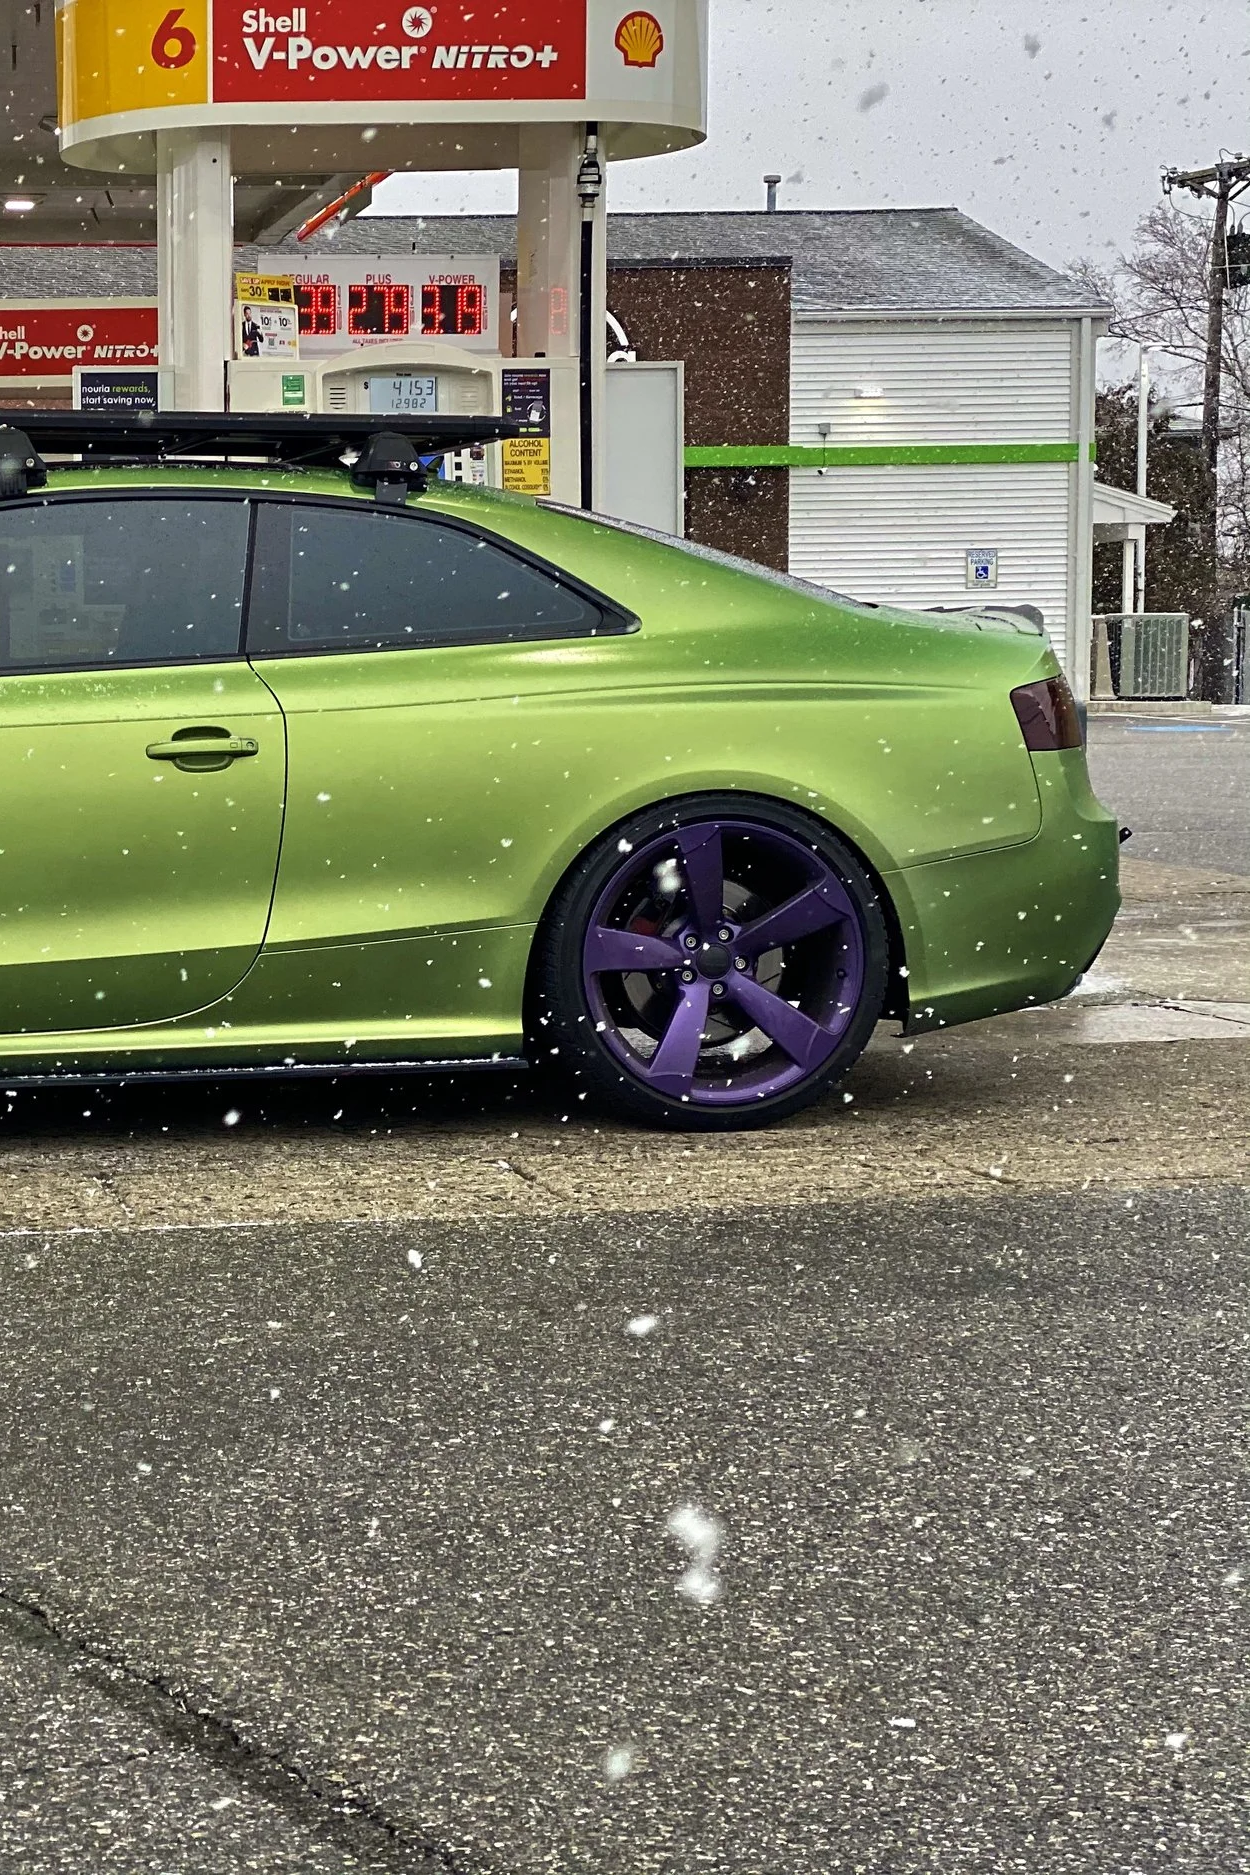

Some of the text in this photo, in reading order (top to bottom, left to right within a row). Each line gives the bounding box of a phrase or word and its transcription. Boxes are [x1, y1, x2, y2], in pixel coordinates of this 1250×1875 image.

[242, 8, 306, 33] Shell
[151, 8, 196, 69] 6
[242, 36, 418, 70] V-Power
[365, 274, 392, 285] PLUS
[429, 275, 476, 285] V-POWER
[363, 381, 369, 390] $
[82, 396, 101, 404] start
[103, 396, 132, 406] saving
[510, 440, 544, 448] ALCOHOL
[510, 449, 542, 457] CONTENT
